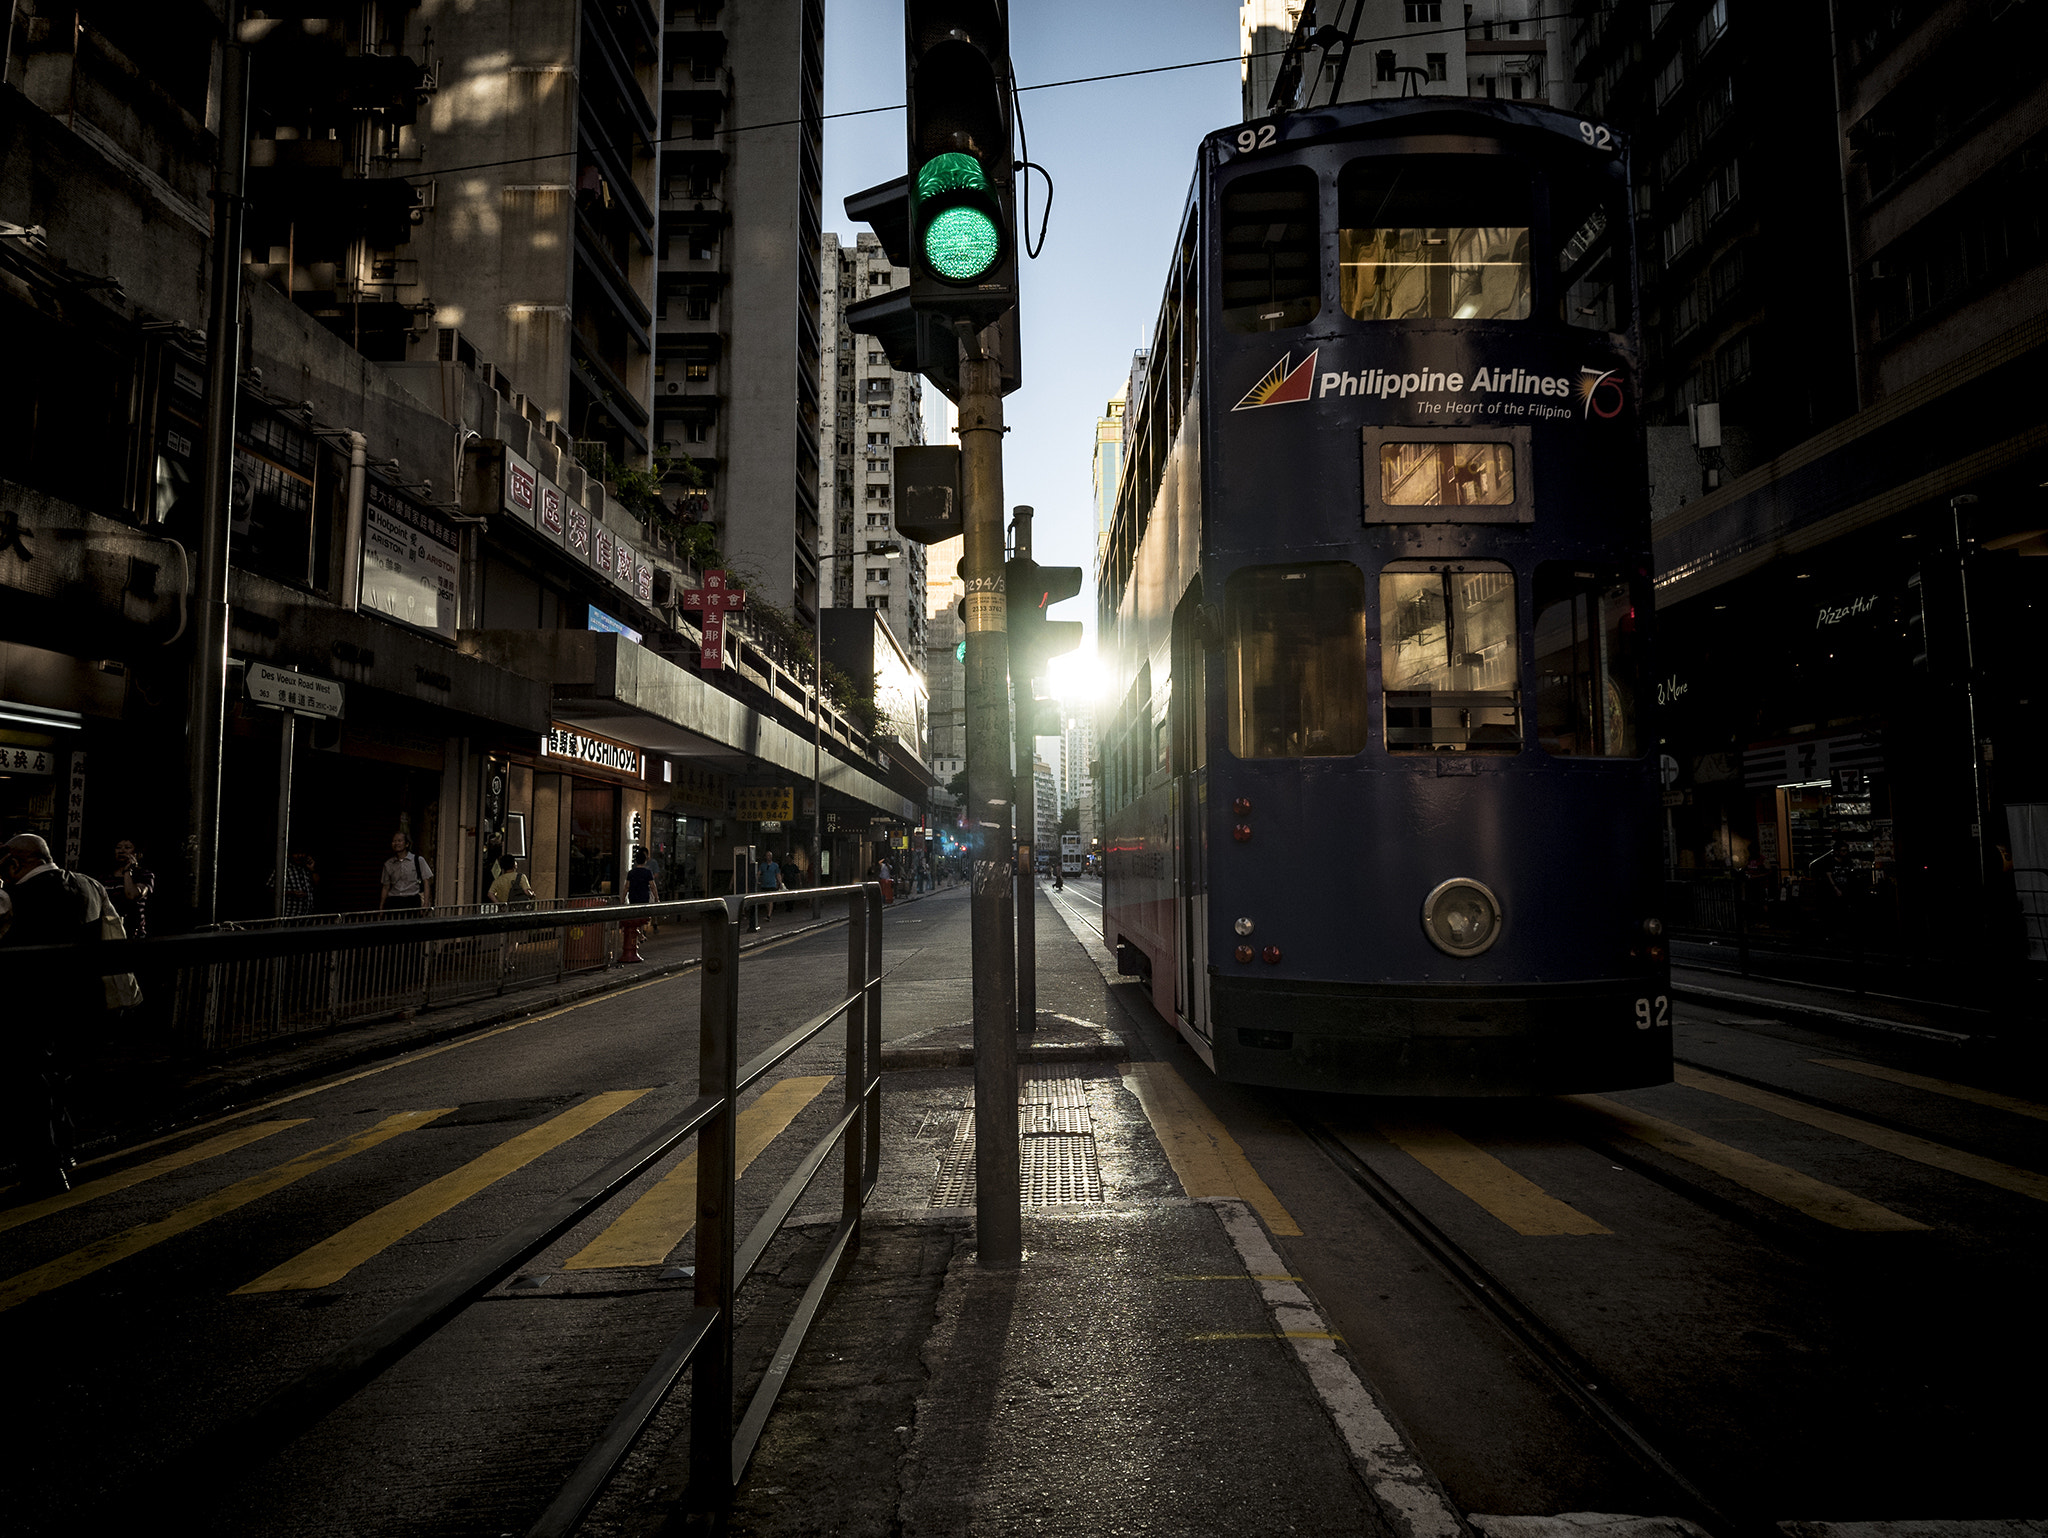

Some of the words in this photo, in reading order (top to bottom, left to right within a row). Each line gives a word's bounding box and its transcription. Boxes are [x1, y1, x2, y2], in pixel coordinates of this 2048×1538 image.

[1237, 124, 1277, 154] 92
[1579, 120, 1612, 151] 92
[1319, 367, 1464, 399] Philippine
[1470, 366, 1570, 398] Airlines
[1416, 401, 1442, 414] The
[1445, 401, 1484, 414] Heart
[1486, 401, 1503, 415] of
[1504, 401, 1524, 415] the
[1528, 403, 1572, 419] Filipino
[376, 512, 408, 541] Hotpoint
[510, 461, 653, 600] 西區浸信教會
[371, 533, 404, 556] ARISTON
[426, 553, 456, 575] ARISTON
[1815, 606, 1850, 630] Pizza
[1850, 594, 1879, 617] Hut
[259, 689, 270, 698] 363
[261, 669, 275, 681] Des
[276, 673, 297, 686] Voeux
[298, 678, 314, 690] Road
[315, 683, 331, 695] West
[1667, 673, 1688, 701] More
[278, 689, 316, 708] 德輔道西
[826, 813, 837, 833] 田谷
[1635, 995, 1669, 1030] 92
